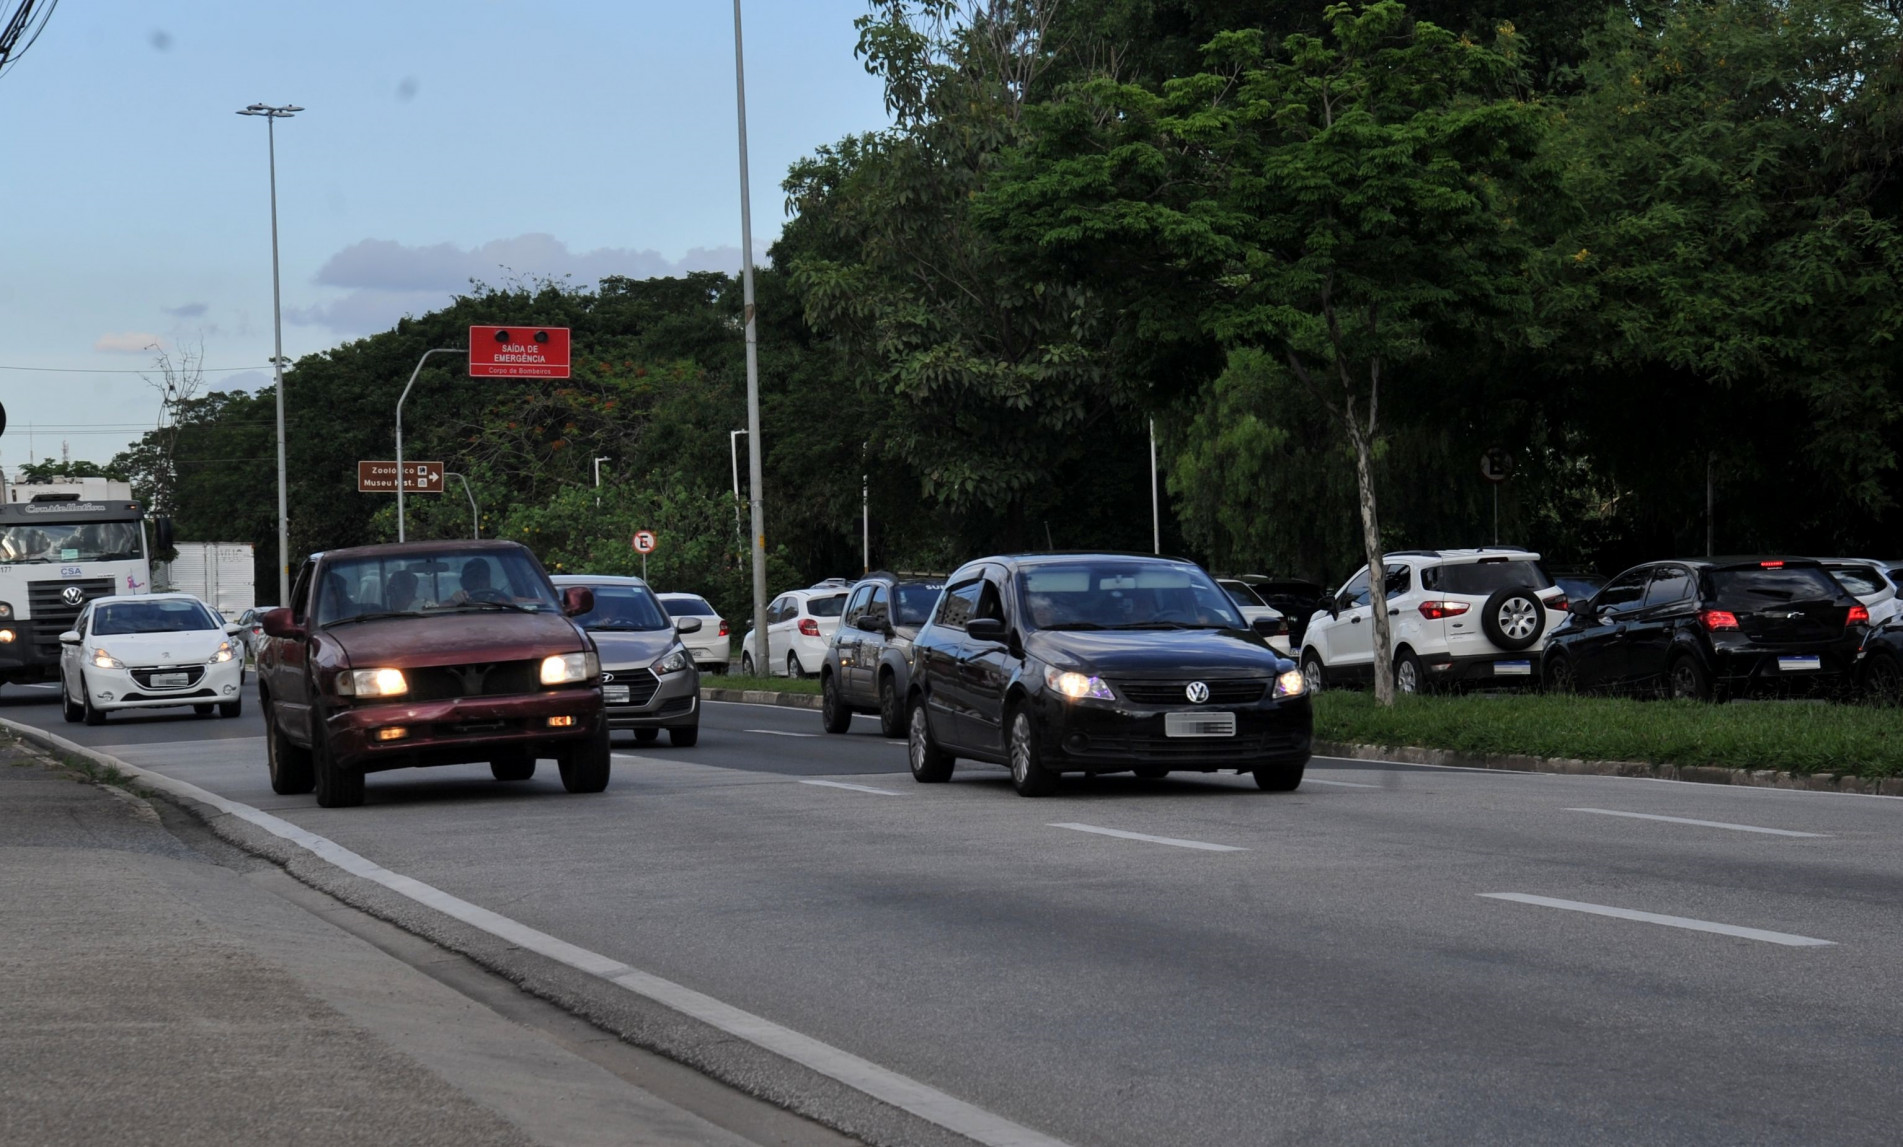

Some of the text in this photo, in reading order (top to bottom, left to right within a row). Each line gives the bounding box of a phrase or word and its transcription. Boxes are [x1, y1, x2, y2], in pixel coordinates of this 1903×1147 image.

[502, 343, 539, 353] SAÍDA DE
[494, 353, 545, 362] EMERGÊNCIA
[372, 466, 415, 474] Zoolóco
[25, 503, 106, 513] Constellation
[60, 567, 82, 575] CSA
